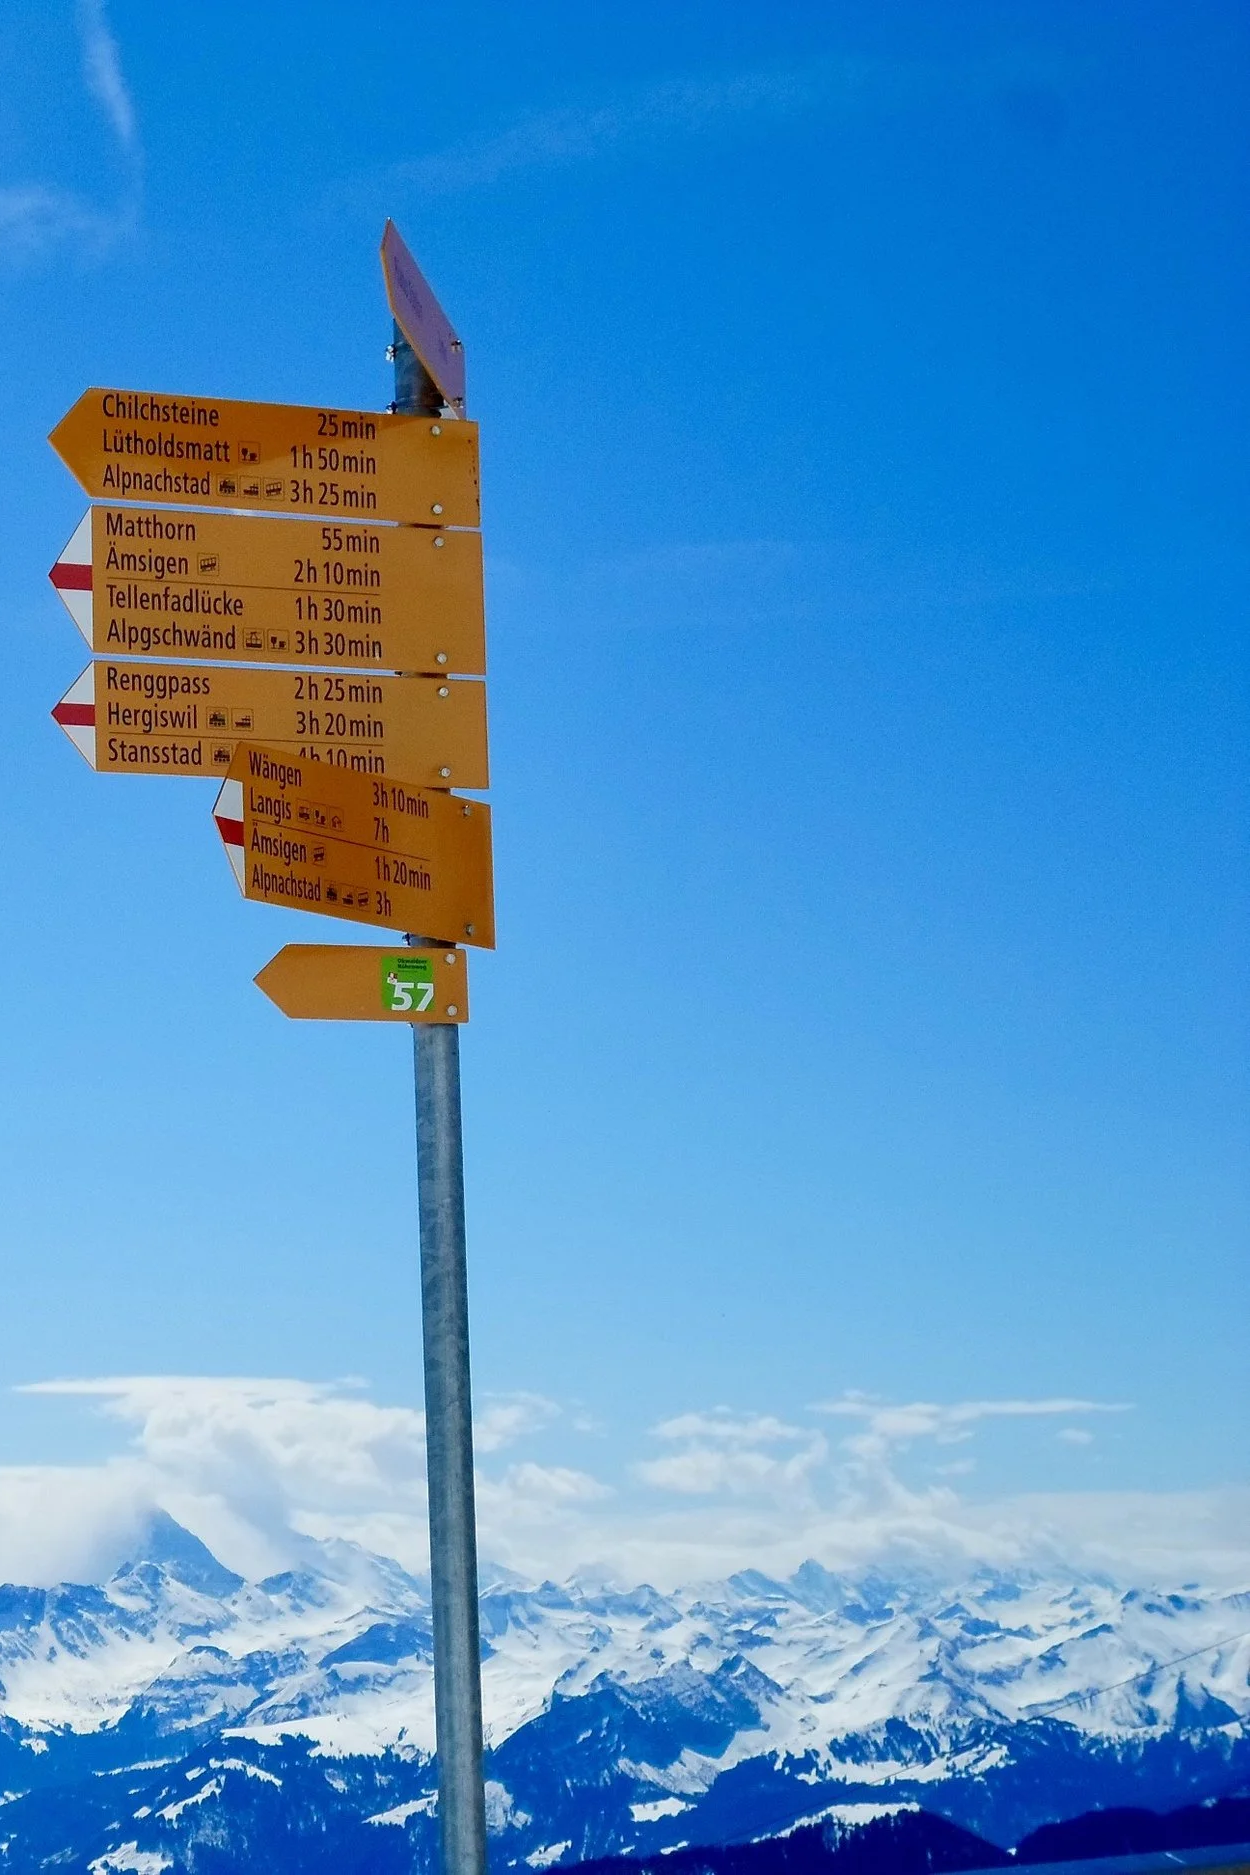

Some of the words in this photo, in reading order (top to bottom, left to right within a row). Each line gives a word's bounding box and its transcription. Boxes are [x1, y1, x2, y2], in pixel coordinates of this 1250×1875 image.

[103, 393, 220, 426] Chilchsteine
[103, 428, 230, 462] Lütholdsmatt
[103, 464, 209, 495] Alpnachstad
[106, 512, 196, 541] Matthorn
[106, 540, 188, 579] Ämsigen
[106, 584, 243, 616] Tellenfadlücke
[107, 618, 235, 650] Alpgschwänd
[107, 666, 210, 699] Renggpass
[107, 701, 198, 733] Hergiswil
[109, 737, 202, 765] Stansstad
[248, 751, 302, 789] Wängen
[250, 788, 292, 823] Langis
[251, 822, 307, 866] Ämsigen
[252, 864, 322, 899] Alpnachstad
[391, 982, 434, 1011] 57
